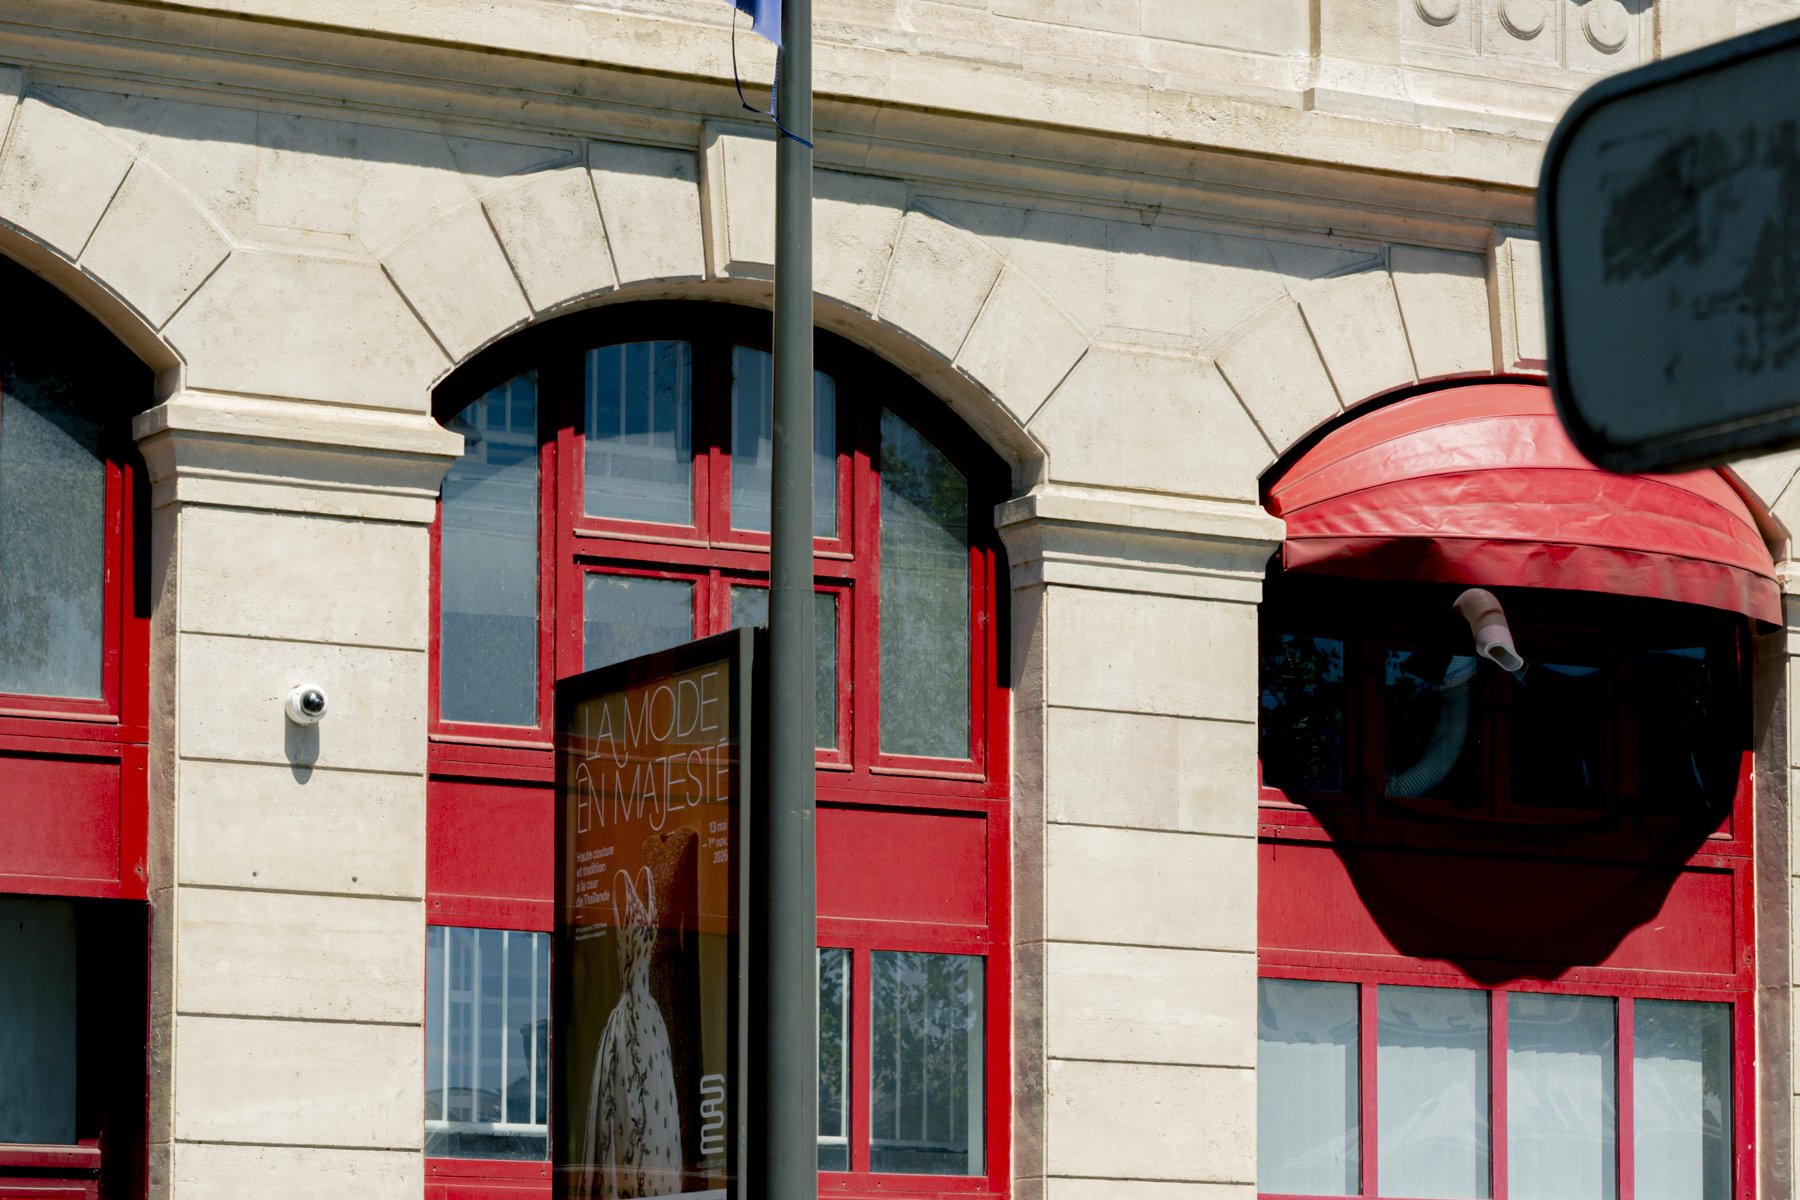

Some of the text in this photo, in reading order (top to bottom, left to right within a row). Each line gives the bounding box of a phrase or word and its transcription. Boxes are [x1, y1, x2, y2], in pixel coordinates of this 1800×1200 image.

[586, 672, 718, 769] LA MODE
[576, 736, 730, 834] EN MAJESTÉ
[709, 818, 729, 833] 13 mai
[716, 837, 729, 848] nov.
[577, 846, 615, 863] Haute couture
[576, 861, 606, 878] et tradition
[581, 878, 586, 891] la
[586, 879, 599, 890] cour
[576, 895, 583, 908] de
